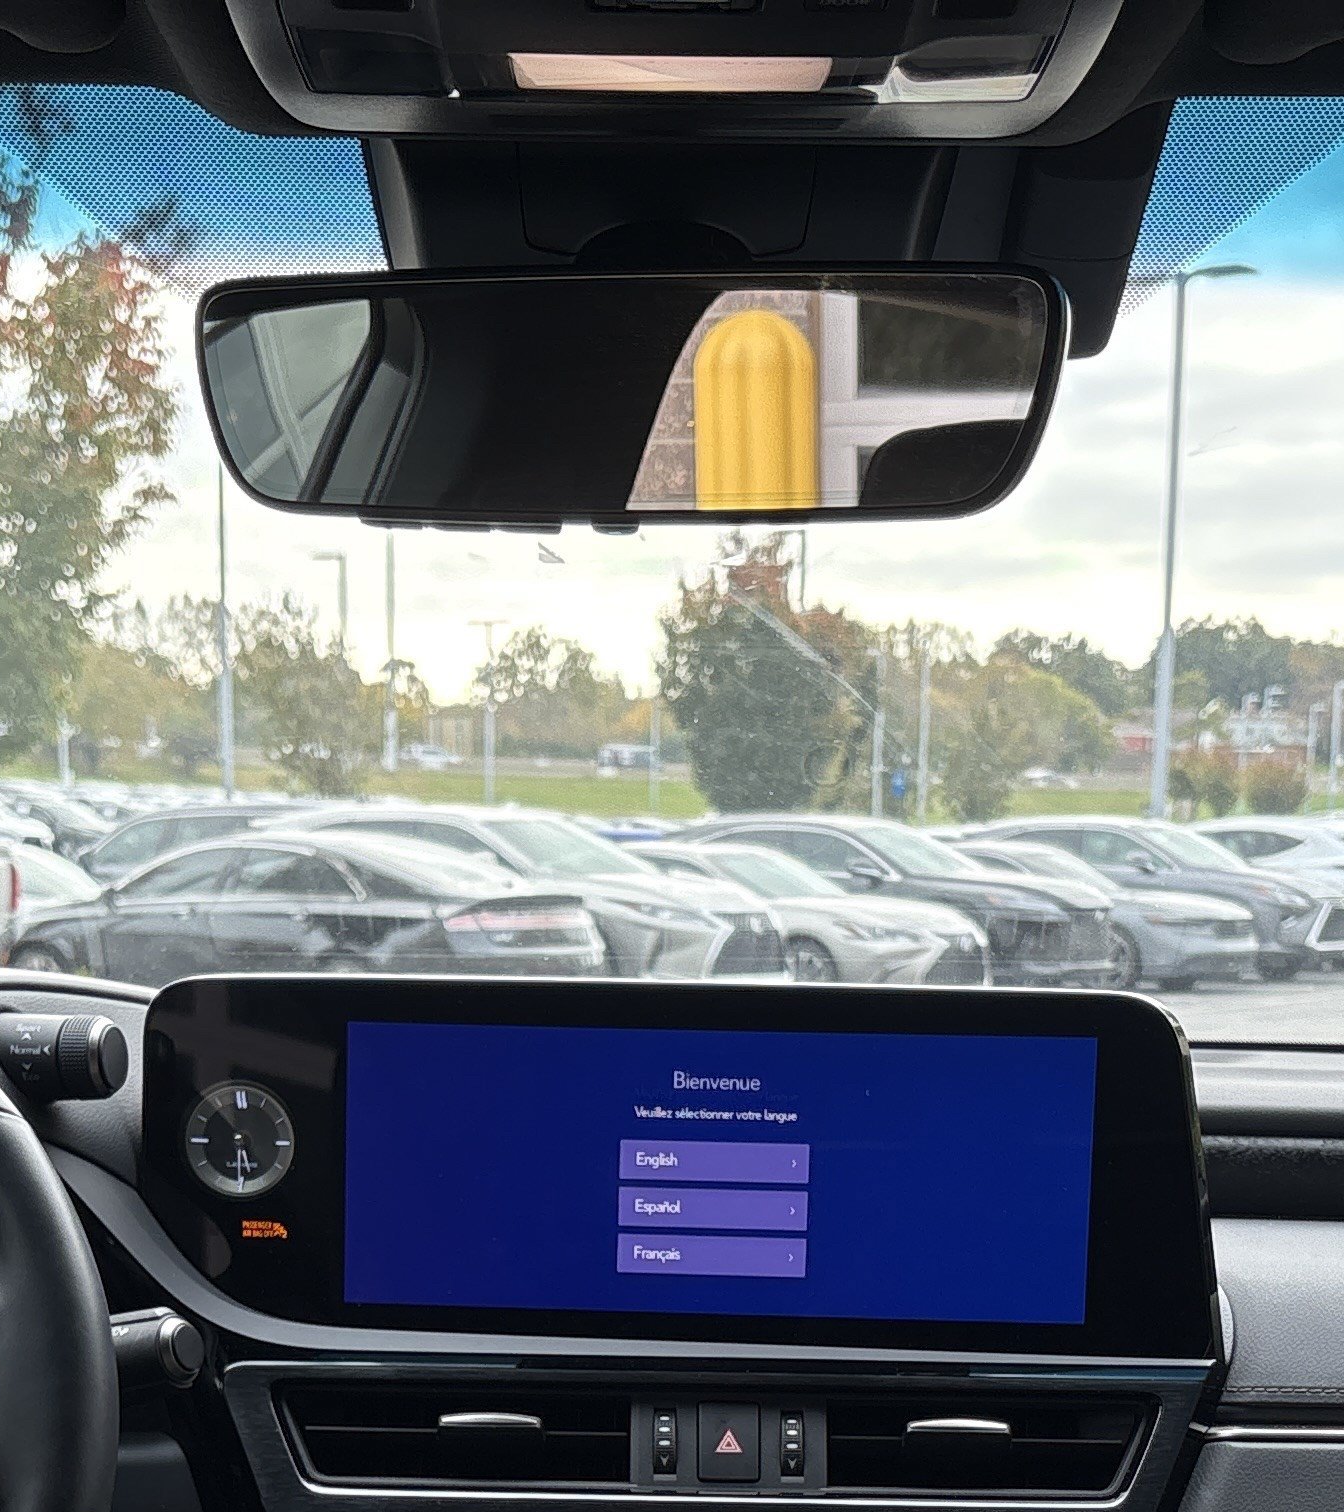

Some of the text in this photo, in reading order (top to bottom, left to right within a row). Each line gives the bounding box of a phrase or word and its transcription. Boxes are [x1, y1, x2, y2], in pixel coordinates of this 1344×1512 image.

[673, 1070, 762, 1092] Bienvenue
[634, 1105, 798, 1124] Veuillez sélectionner votre langue
[635, 1151, 679, 1170] English
[634, 1198, 682, 1216] Español
[633, 1244, 682, 1264] Français
